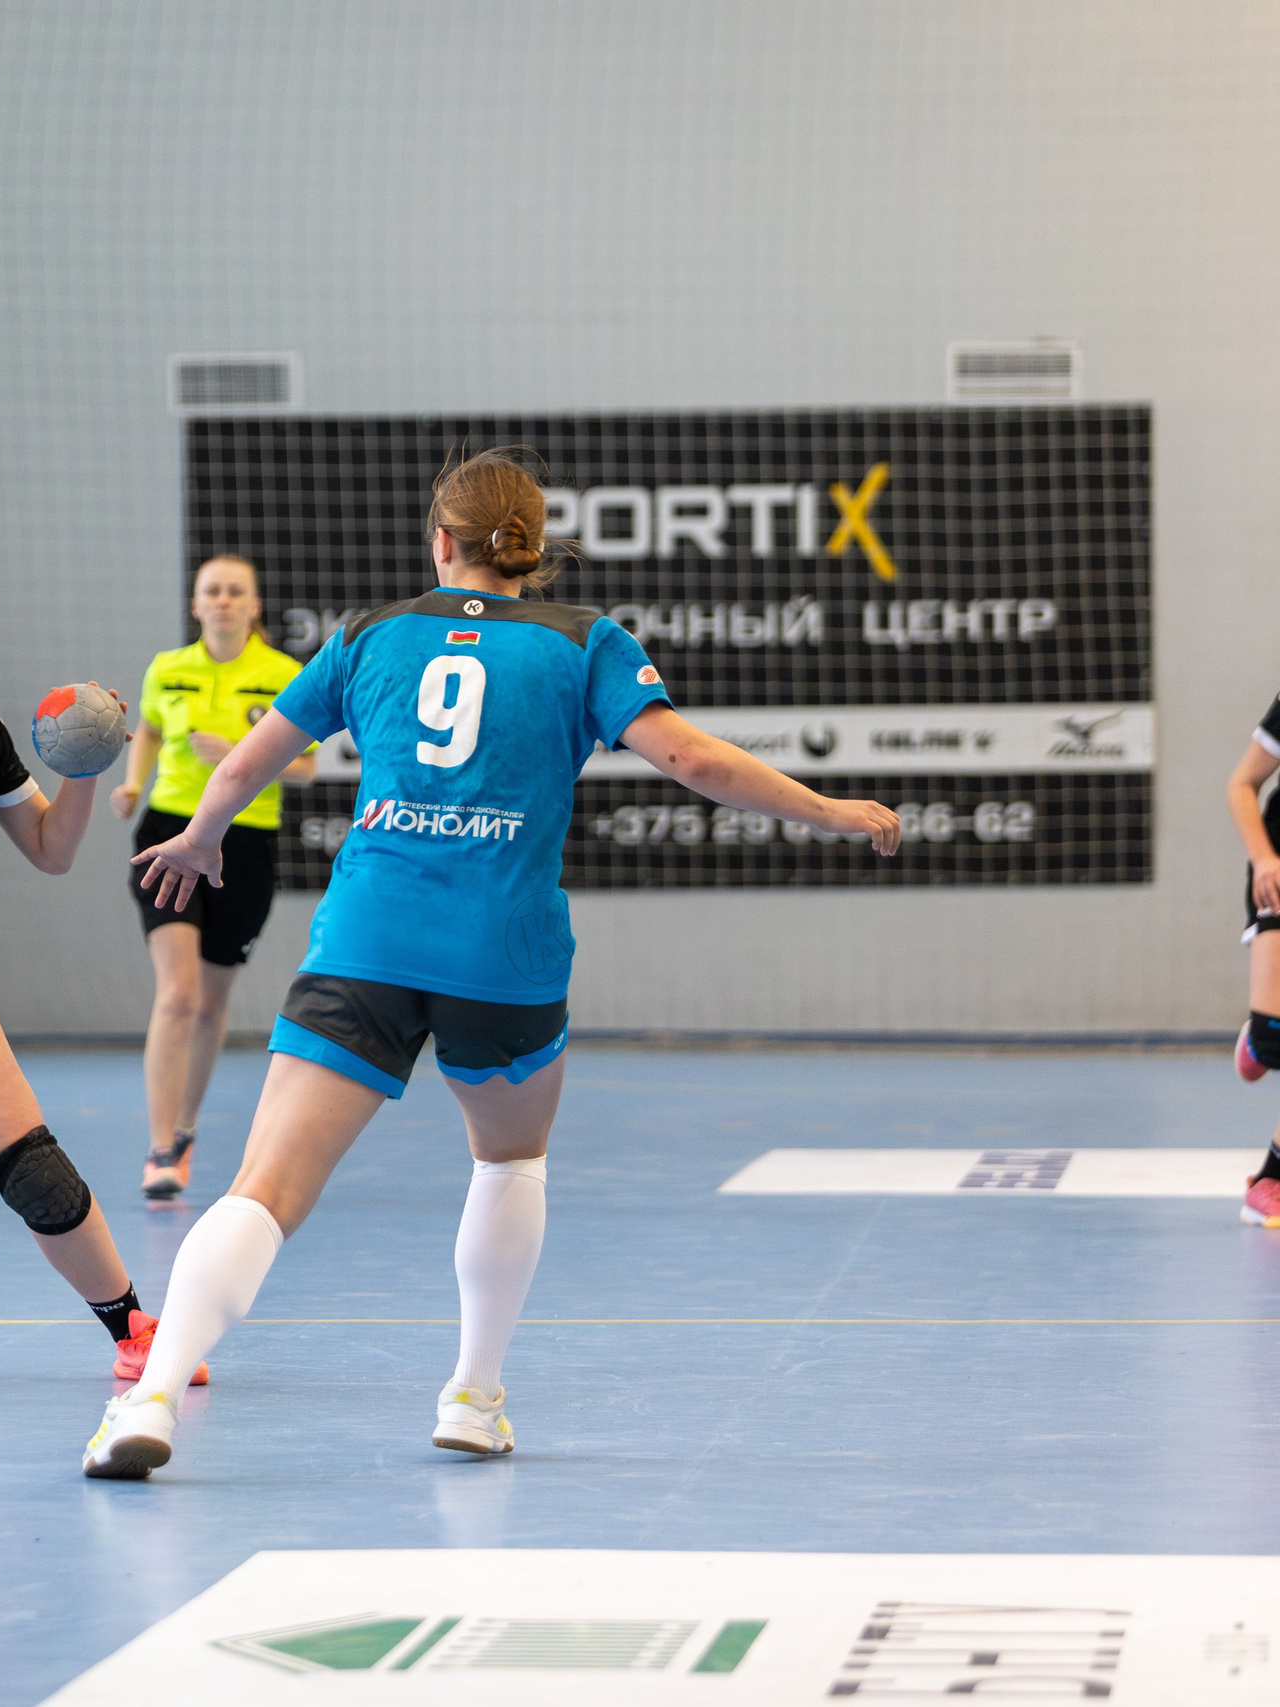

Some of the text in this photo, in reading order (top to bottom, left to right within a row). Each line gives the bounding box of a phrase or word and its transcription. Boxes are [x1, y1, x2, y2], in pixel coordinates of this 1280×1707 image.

[862, 598, 1060, 652] ЦЕНТР
[417, 655, 486, 768] 9
[398, 800, 525, 819] ВИТЕБСКИЙ ЗАВОД РАДИОДЕТАЛЕЙ
